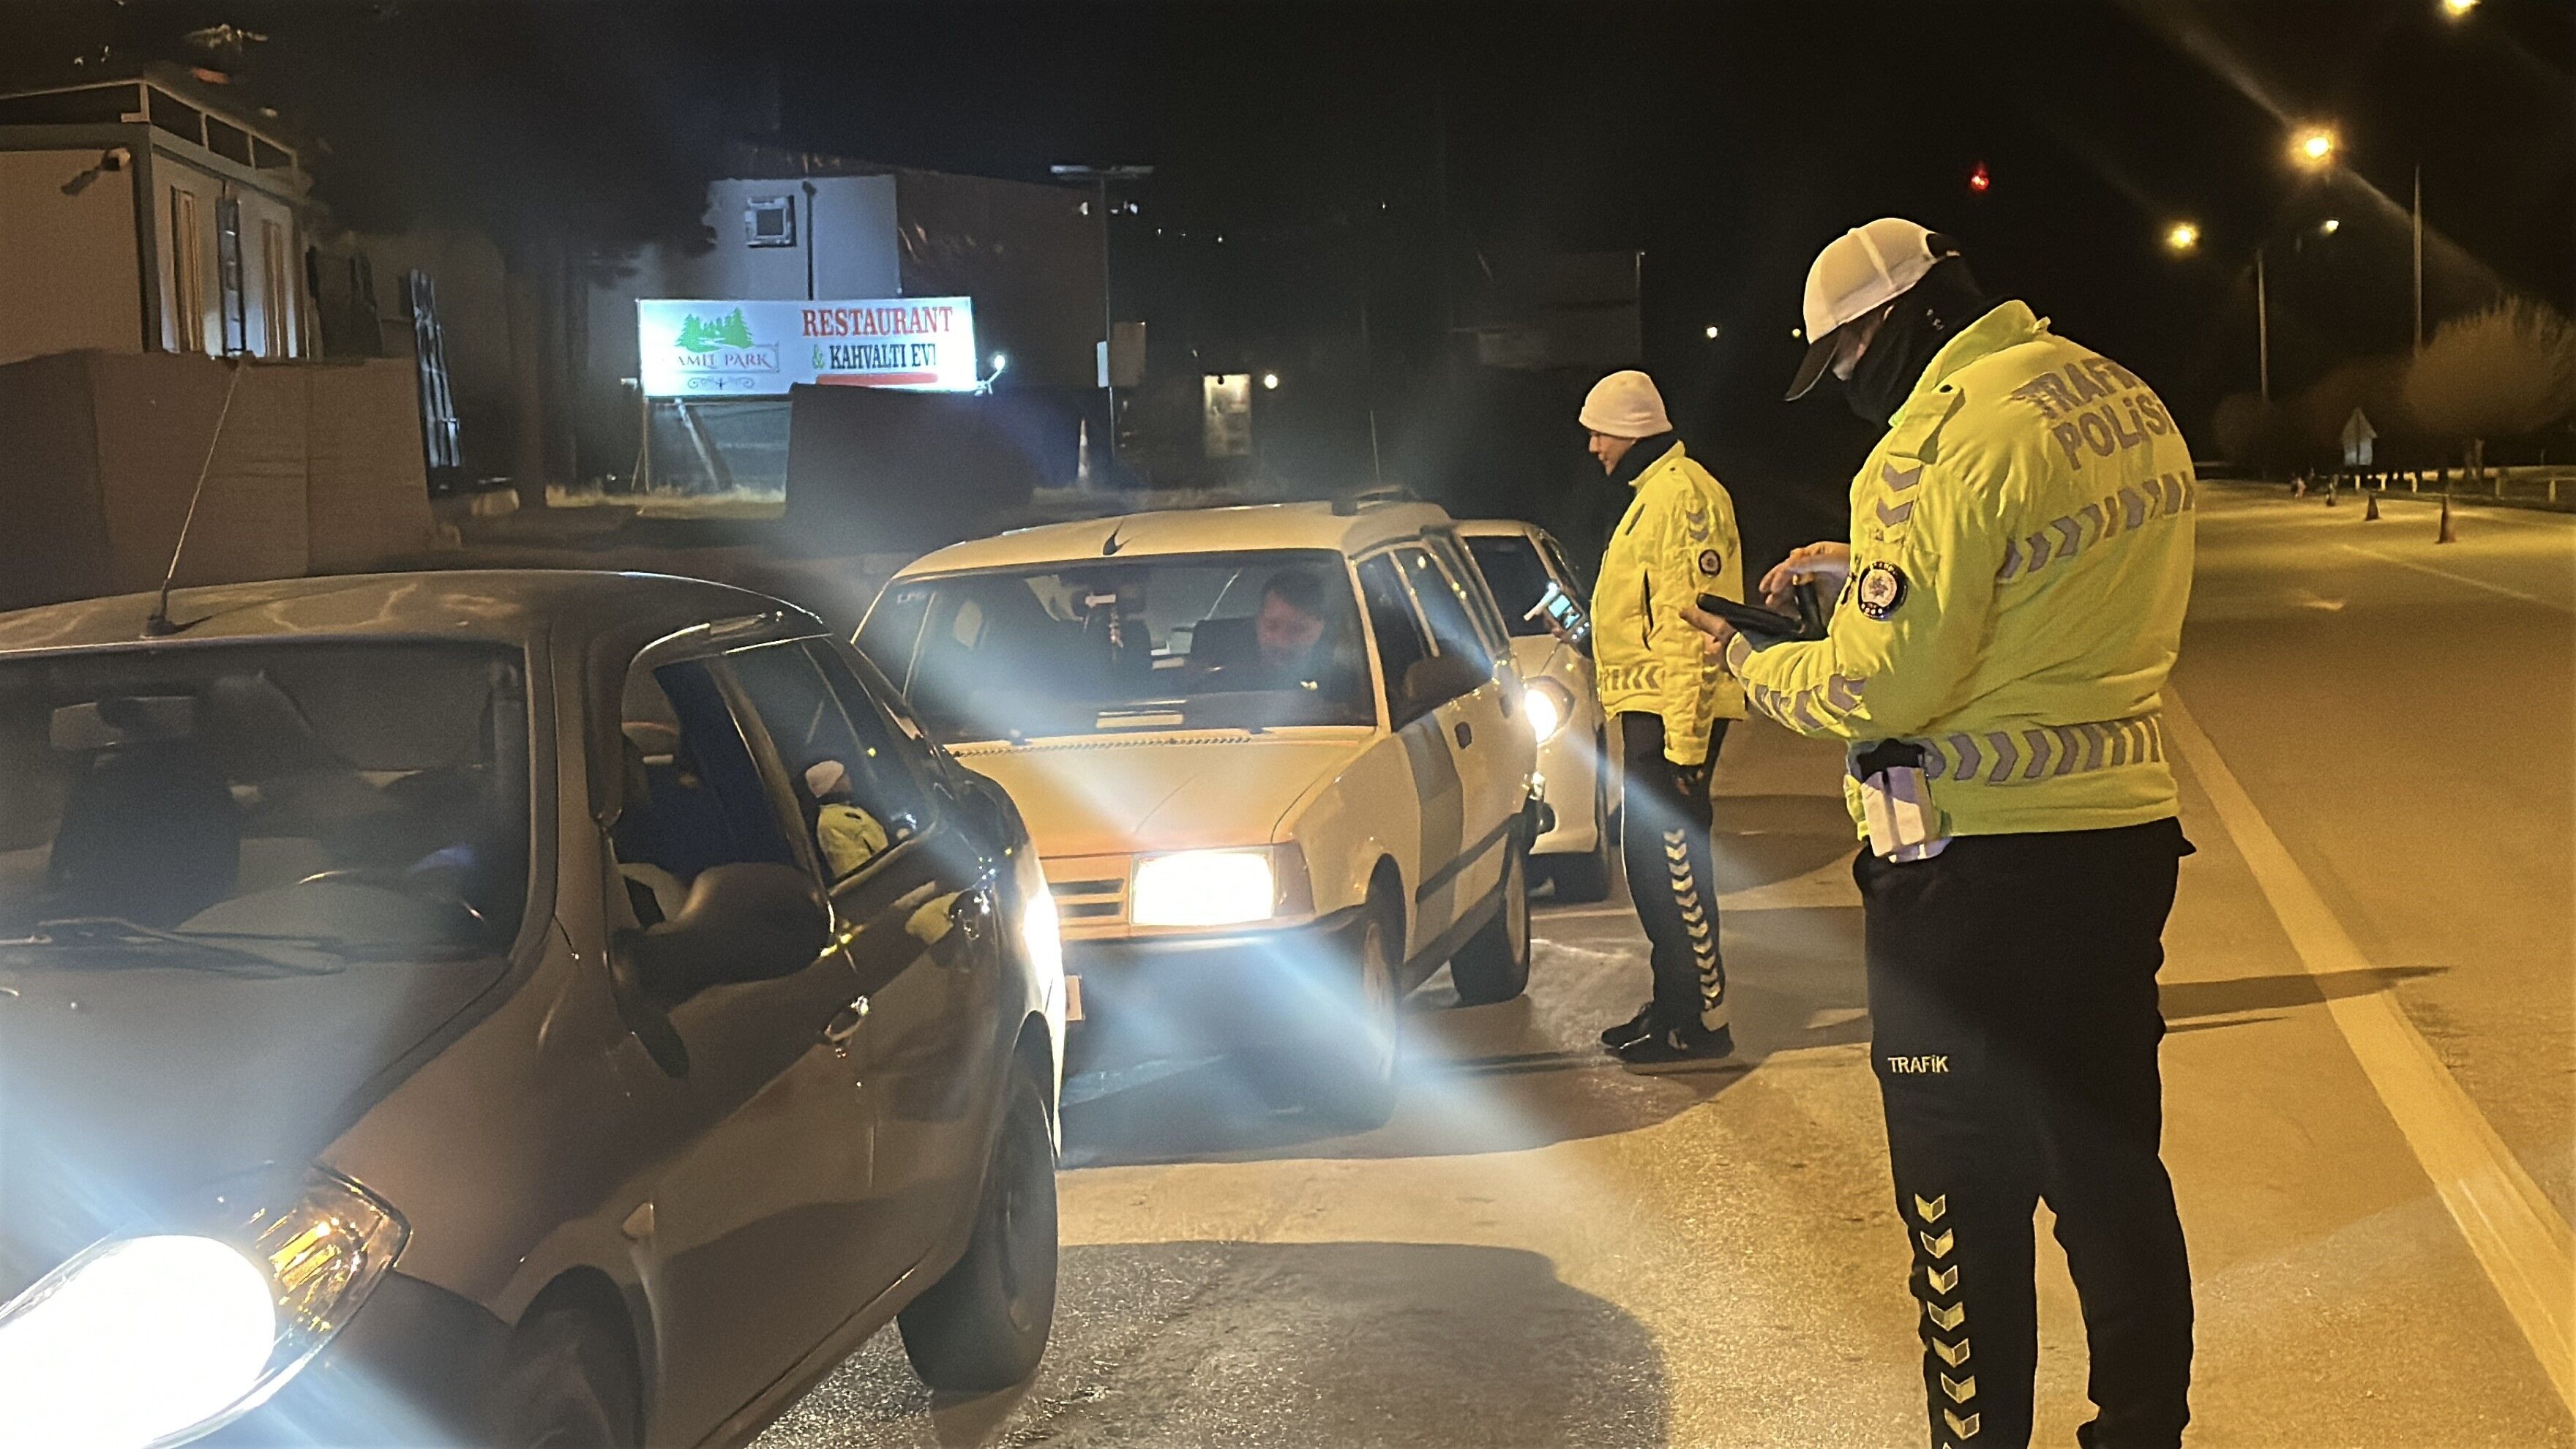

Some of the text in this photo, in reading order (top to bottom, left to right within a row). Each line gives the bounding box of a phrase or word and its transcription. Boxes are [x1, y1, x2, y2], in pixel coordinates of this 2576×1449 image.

[802, 307, 953, 337] RESTAURANT
[724, 353, 774, 369] PARK
[812, 345, 825, 369] &
[829, 344, 907, 370] KAHVALTI
[1887, 1055, 1950, 1073] TRAFİK
